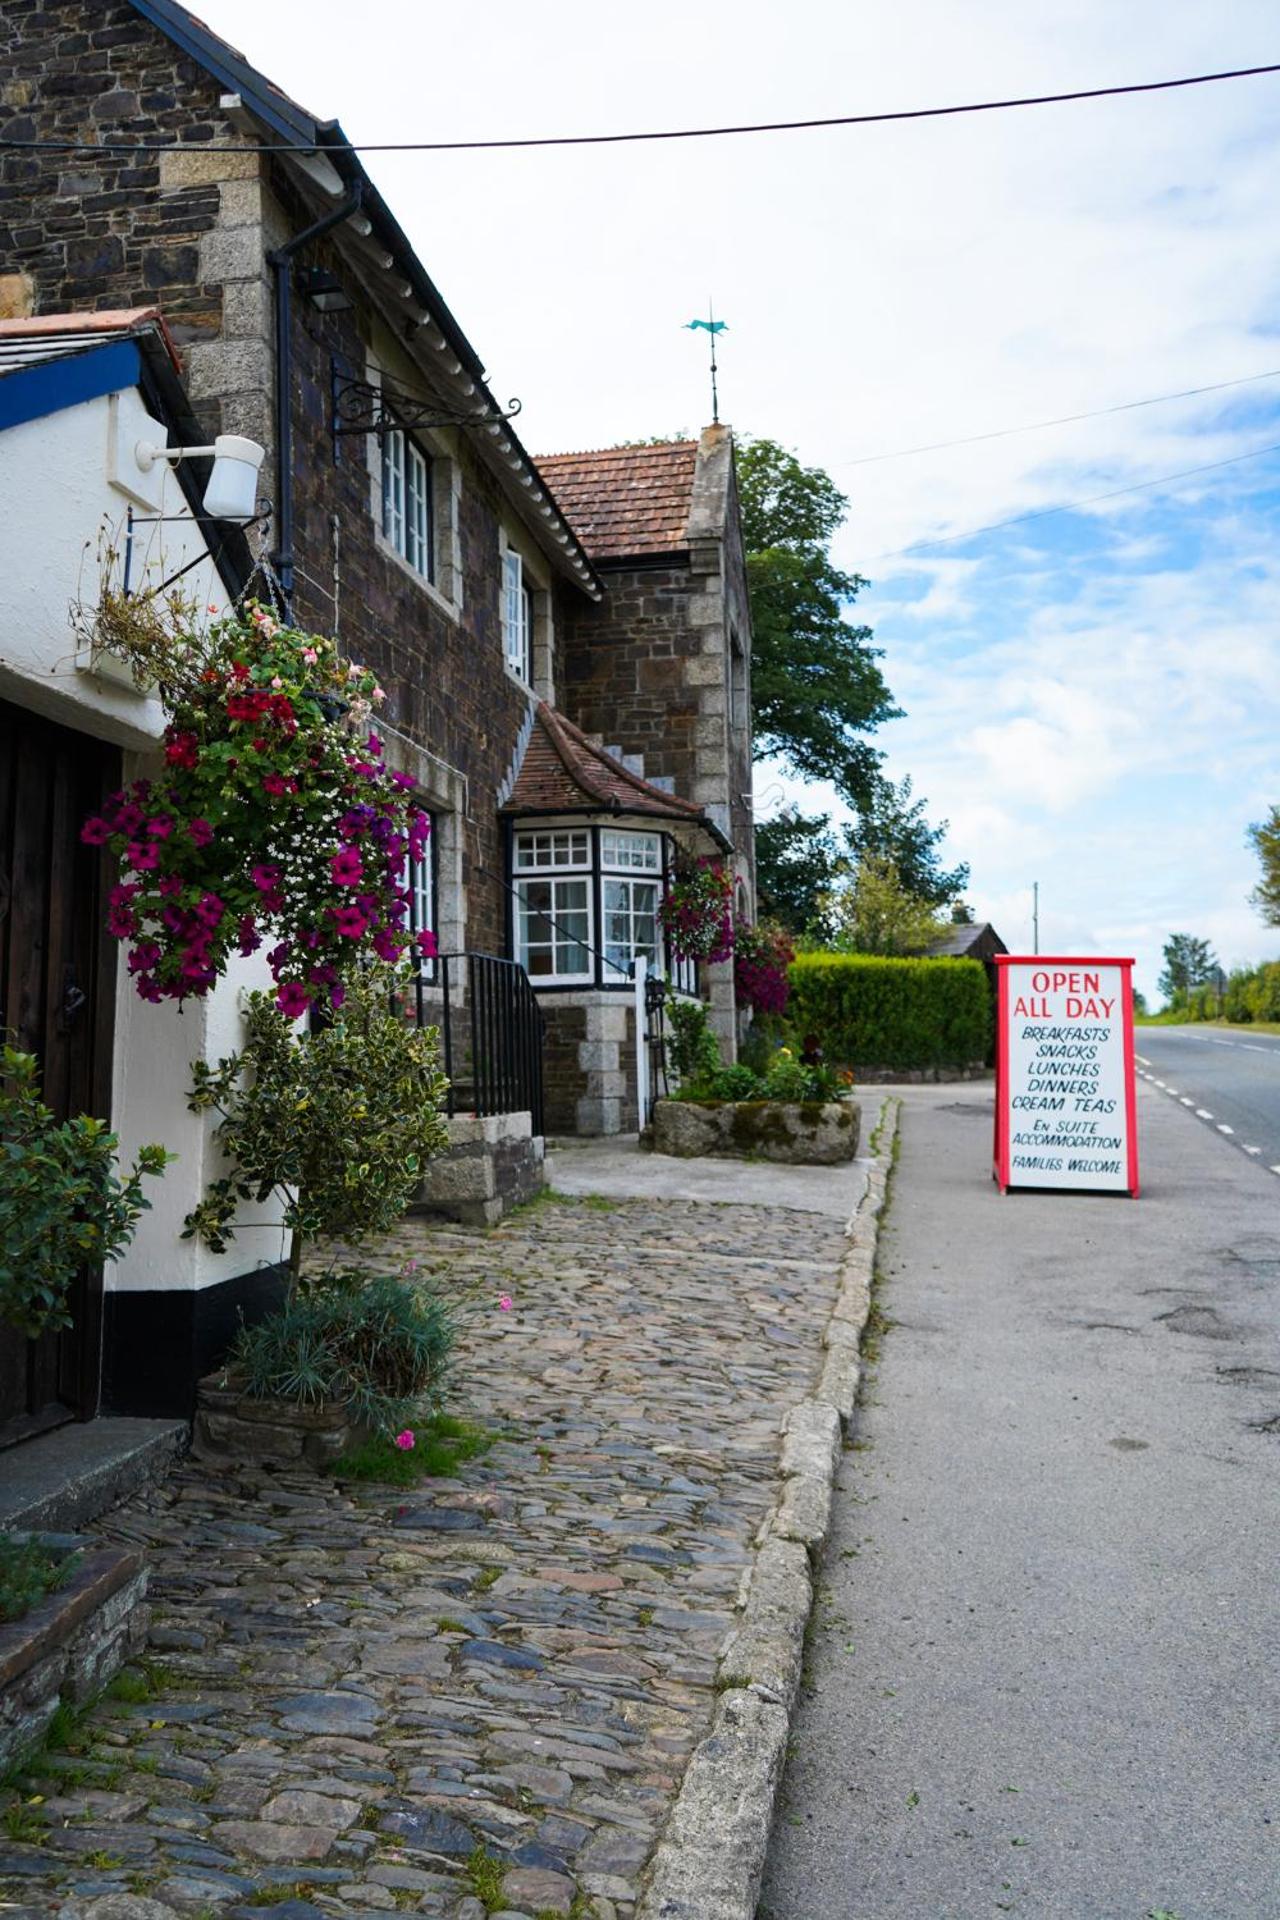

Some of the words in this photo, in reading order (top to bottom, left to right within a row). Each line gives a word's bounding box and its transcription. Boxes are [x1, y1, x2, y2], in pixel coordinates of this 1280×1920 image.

[1032, 971, 1099, 993] OPEN
[1013, 997, 1052, 1018] ALL
[1066, 997, 1116, 1018] DAY
[1022, 1026, 1110, 1043] BREAKFASTS
[1036, 1044, 1098, 1060] SNACKS
[1028, 1061, 1100, 1077] LUNCHES
[1027, 1079, 1099, 1096] DINNERS
[1011, 1096, 1065, 1111] CREAM
[1074, 1098, 1117, 1114] TEAS
[1055, 1121, 1099, 1134] SUITE
[1012, 1132, 1121, 1149] ACCOMMODATION
[1012, 1155, 1063, 1171] FAMILIES
[1067, 1158, 1122, 1174] WELCOME
